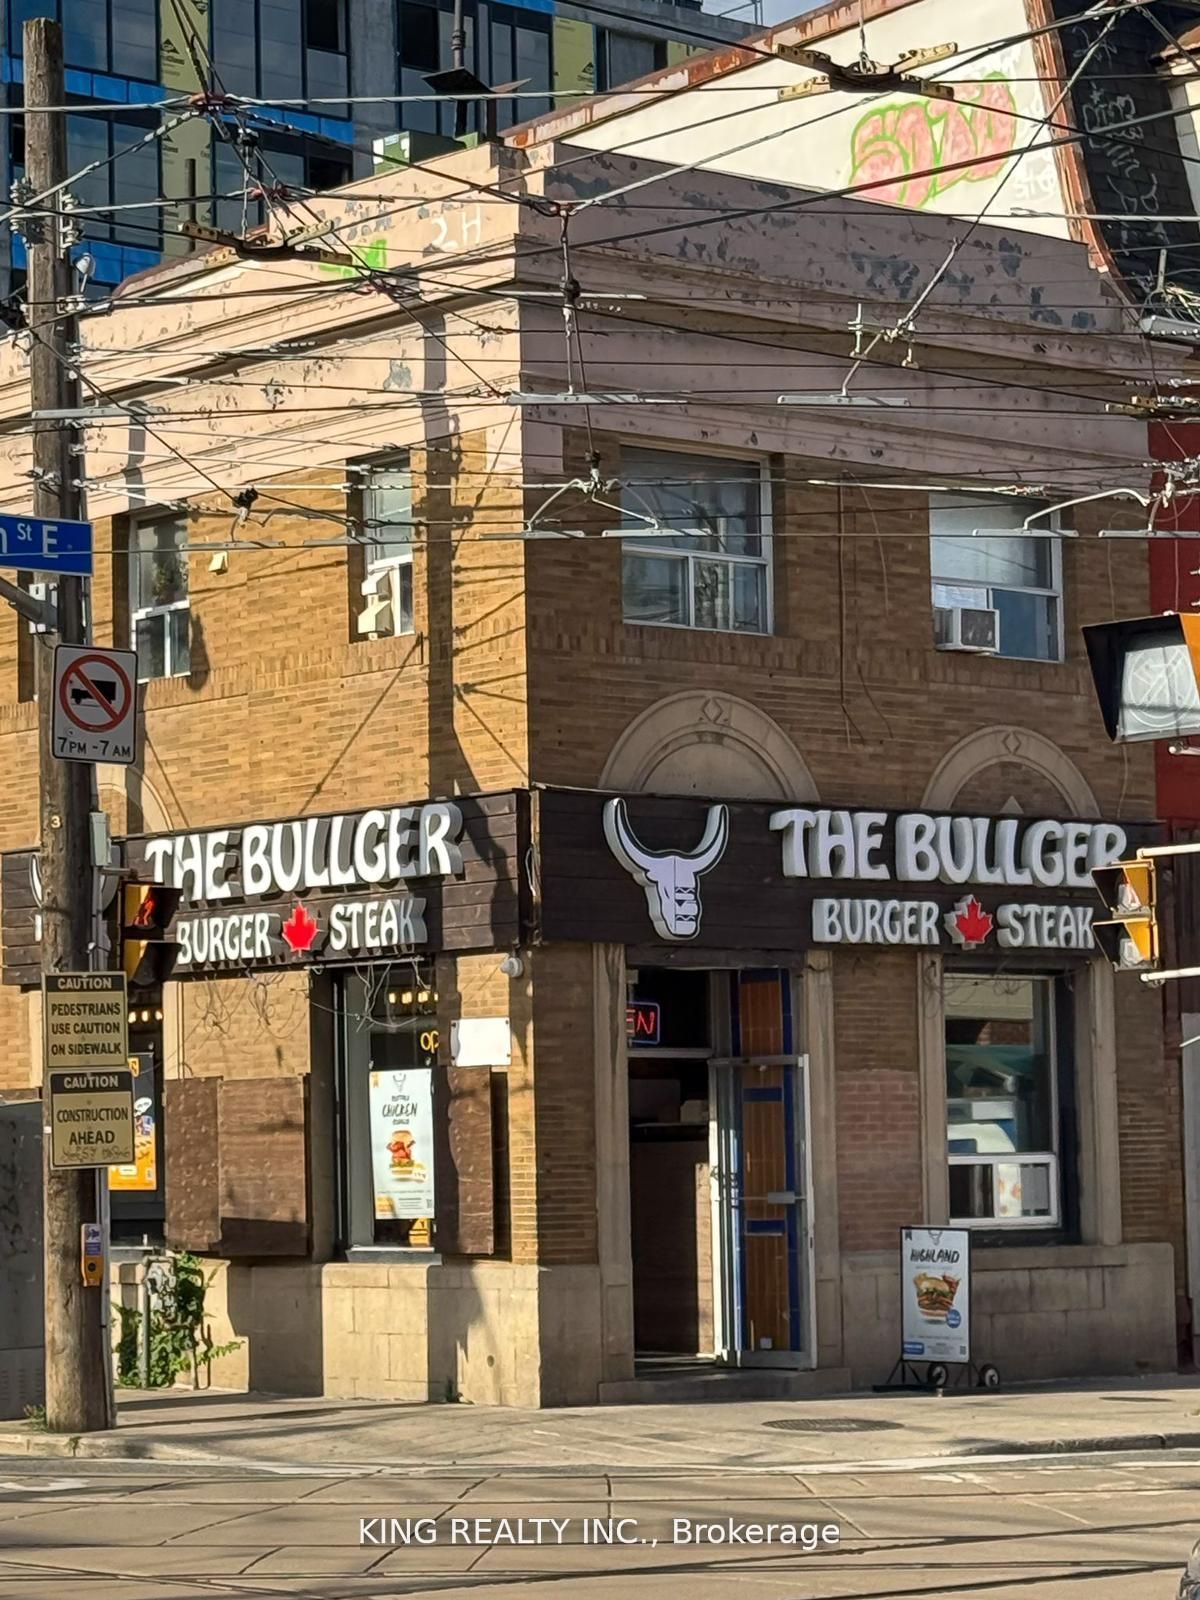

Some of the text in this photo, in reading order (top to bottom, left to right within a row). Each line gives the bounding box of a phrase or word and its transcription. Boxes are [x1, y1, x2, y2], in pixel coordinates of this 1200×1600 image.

[17, 523, 33, 541] St
[42, 525, 59, 559] E
[144, 801, 463, 902] THE BULLGER
[769, 809, 891, 881] THE
[175, 897, 426, 966] BURGER STEAK
[812, 898, 1096, 950] BURGER STEAK
[57, 977, 112, 990] CAUTION
[51, 1002, 121, 1017] PEDESTRIANS
[51, 1022, 121, 1035] USE CAUTION
[51, 1042, 122, 1056] ON SIDEWALK
[63, 1075, 119, 1089] CAUTION
[56, 1107, 129, 1123] CONSTRUCTION
[382, 1102, 418, 1118] CHICKEN
[68, 1130, 116, 1146] AHEAD
[910, 1248, 960, 1264] HIGHLAND
